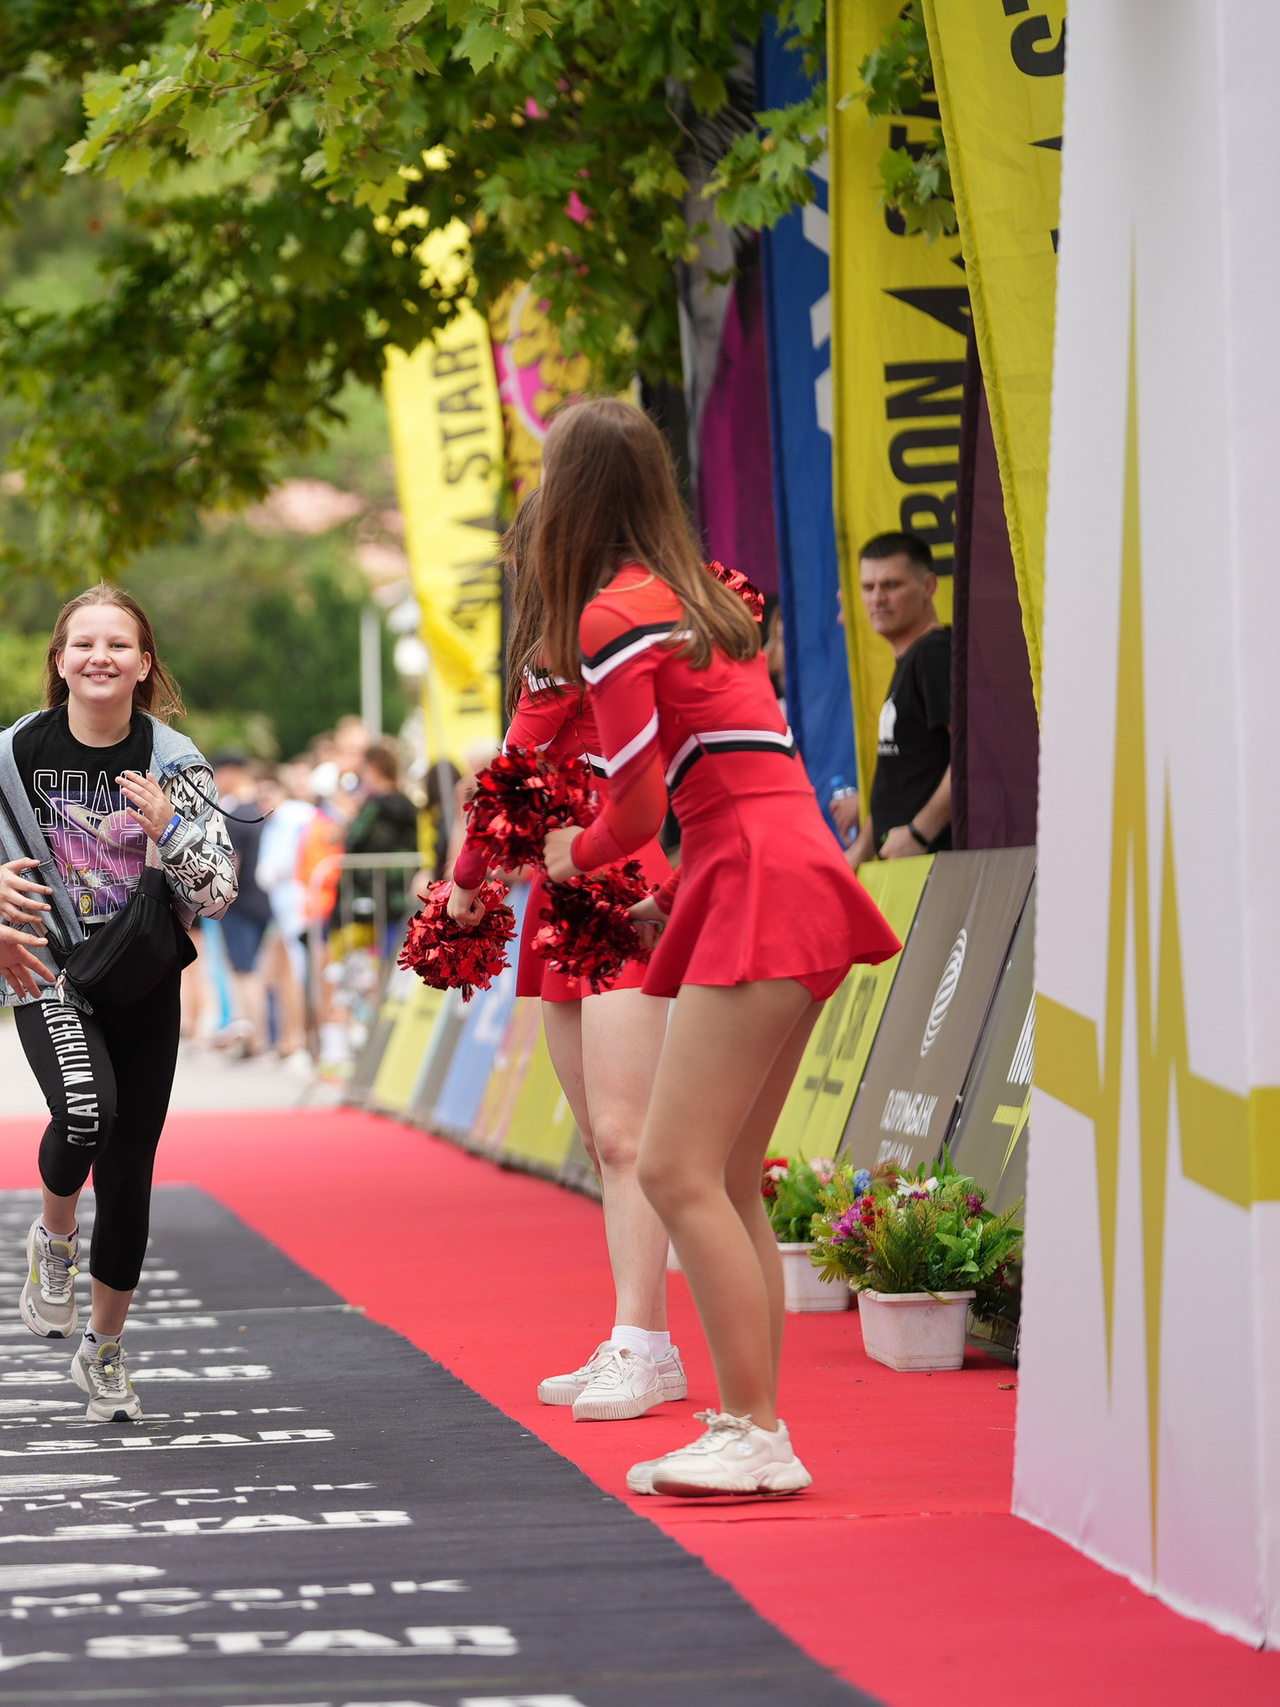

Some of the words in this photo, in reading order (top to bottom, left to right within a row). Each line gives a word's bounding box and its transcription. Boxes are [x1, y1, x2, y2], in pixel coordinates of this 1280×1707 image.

[432, 341, 492, 484] STAR
[27, 1303, 36, 1319] FILA
[1, 1365, 273, 1383] SAR
[25, 1429, 335, 1451] STAR
[53, 1510, 413, 1537] STAR
[85, 1625, 518, 1659] STAR
